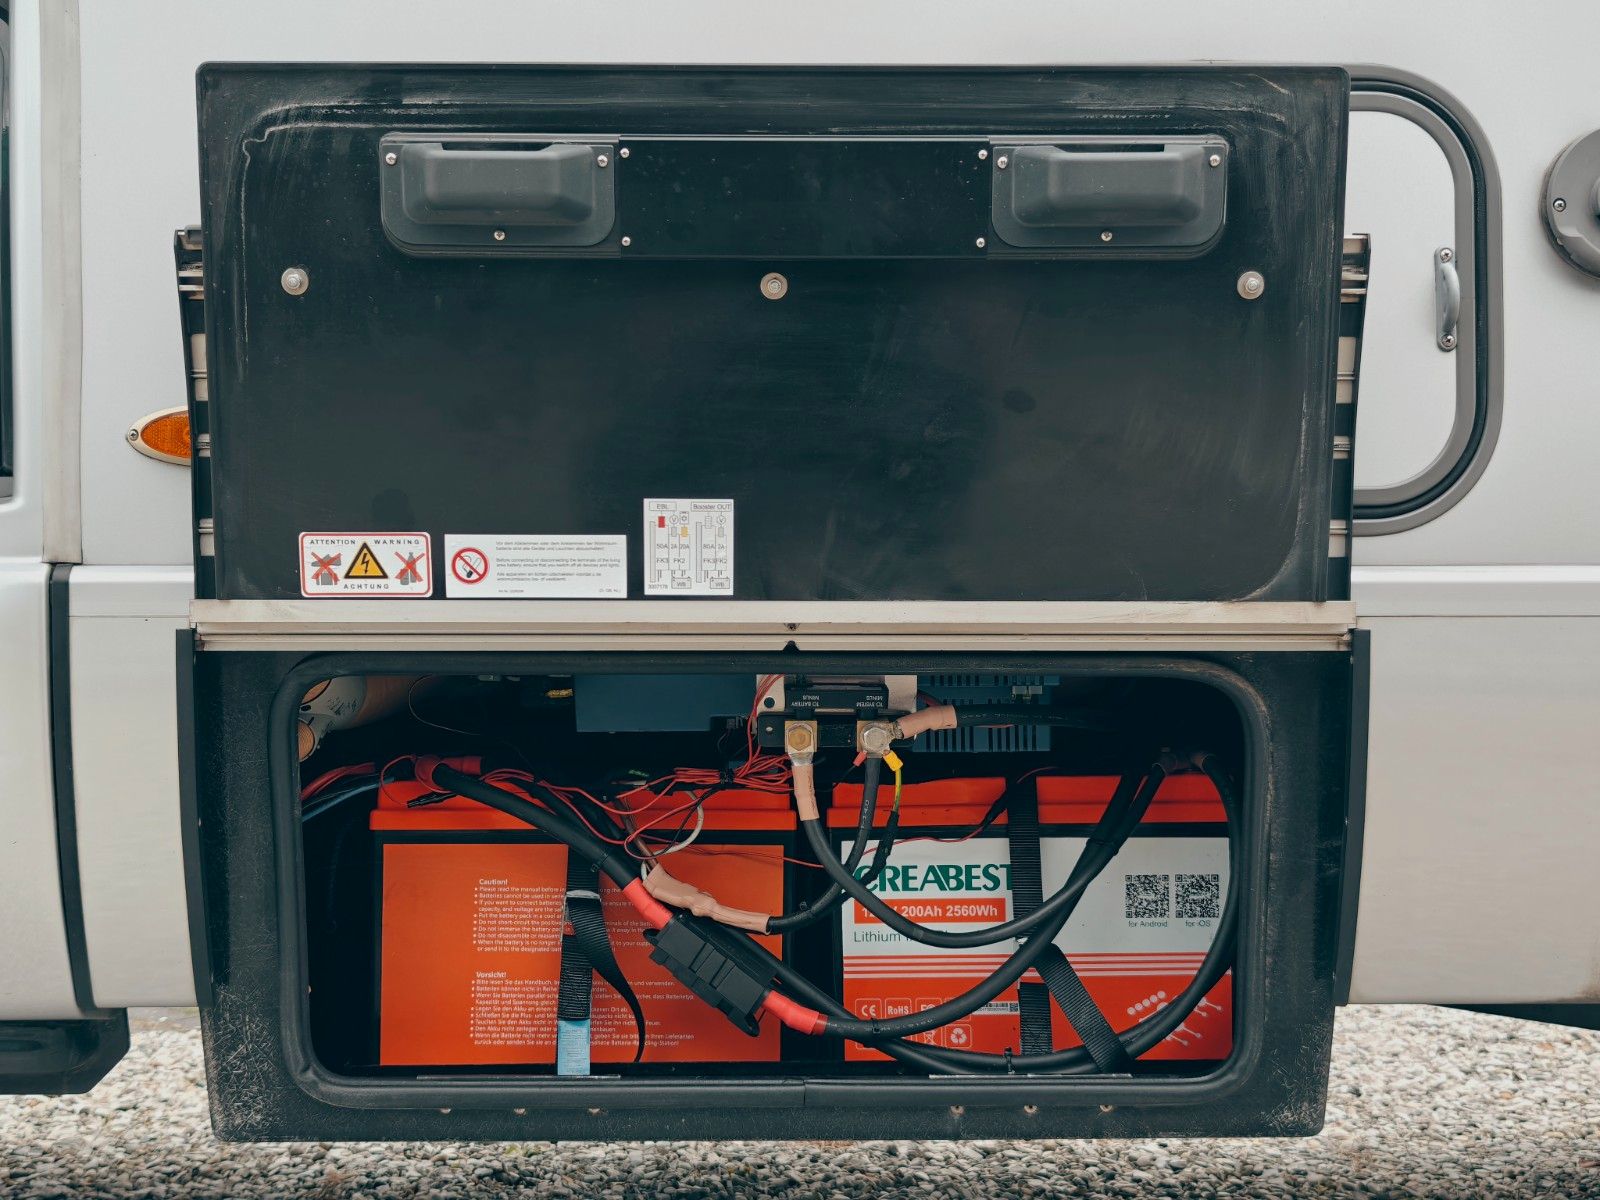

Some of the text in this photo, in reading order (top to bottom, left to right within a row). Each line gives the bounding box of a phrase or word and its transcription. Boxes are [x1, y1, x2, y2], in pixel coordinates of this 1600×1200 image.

[479, 878, 508, 886] Caution!
[901, 905, 942, 918] 200Ah
[946, 904, 998, 918] 2560Wh
[1128, 920, 1168, 928] for Android
[853, 931, 901, 943] Lithium
[861, 1005, 877, 1017] CE
[887, 1005, 909, 1016] RoHS
